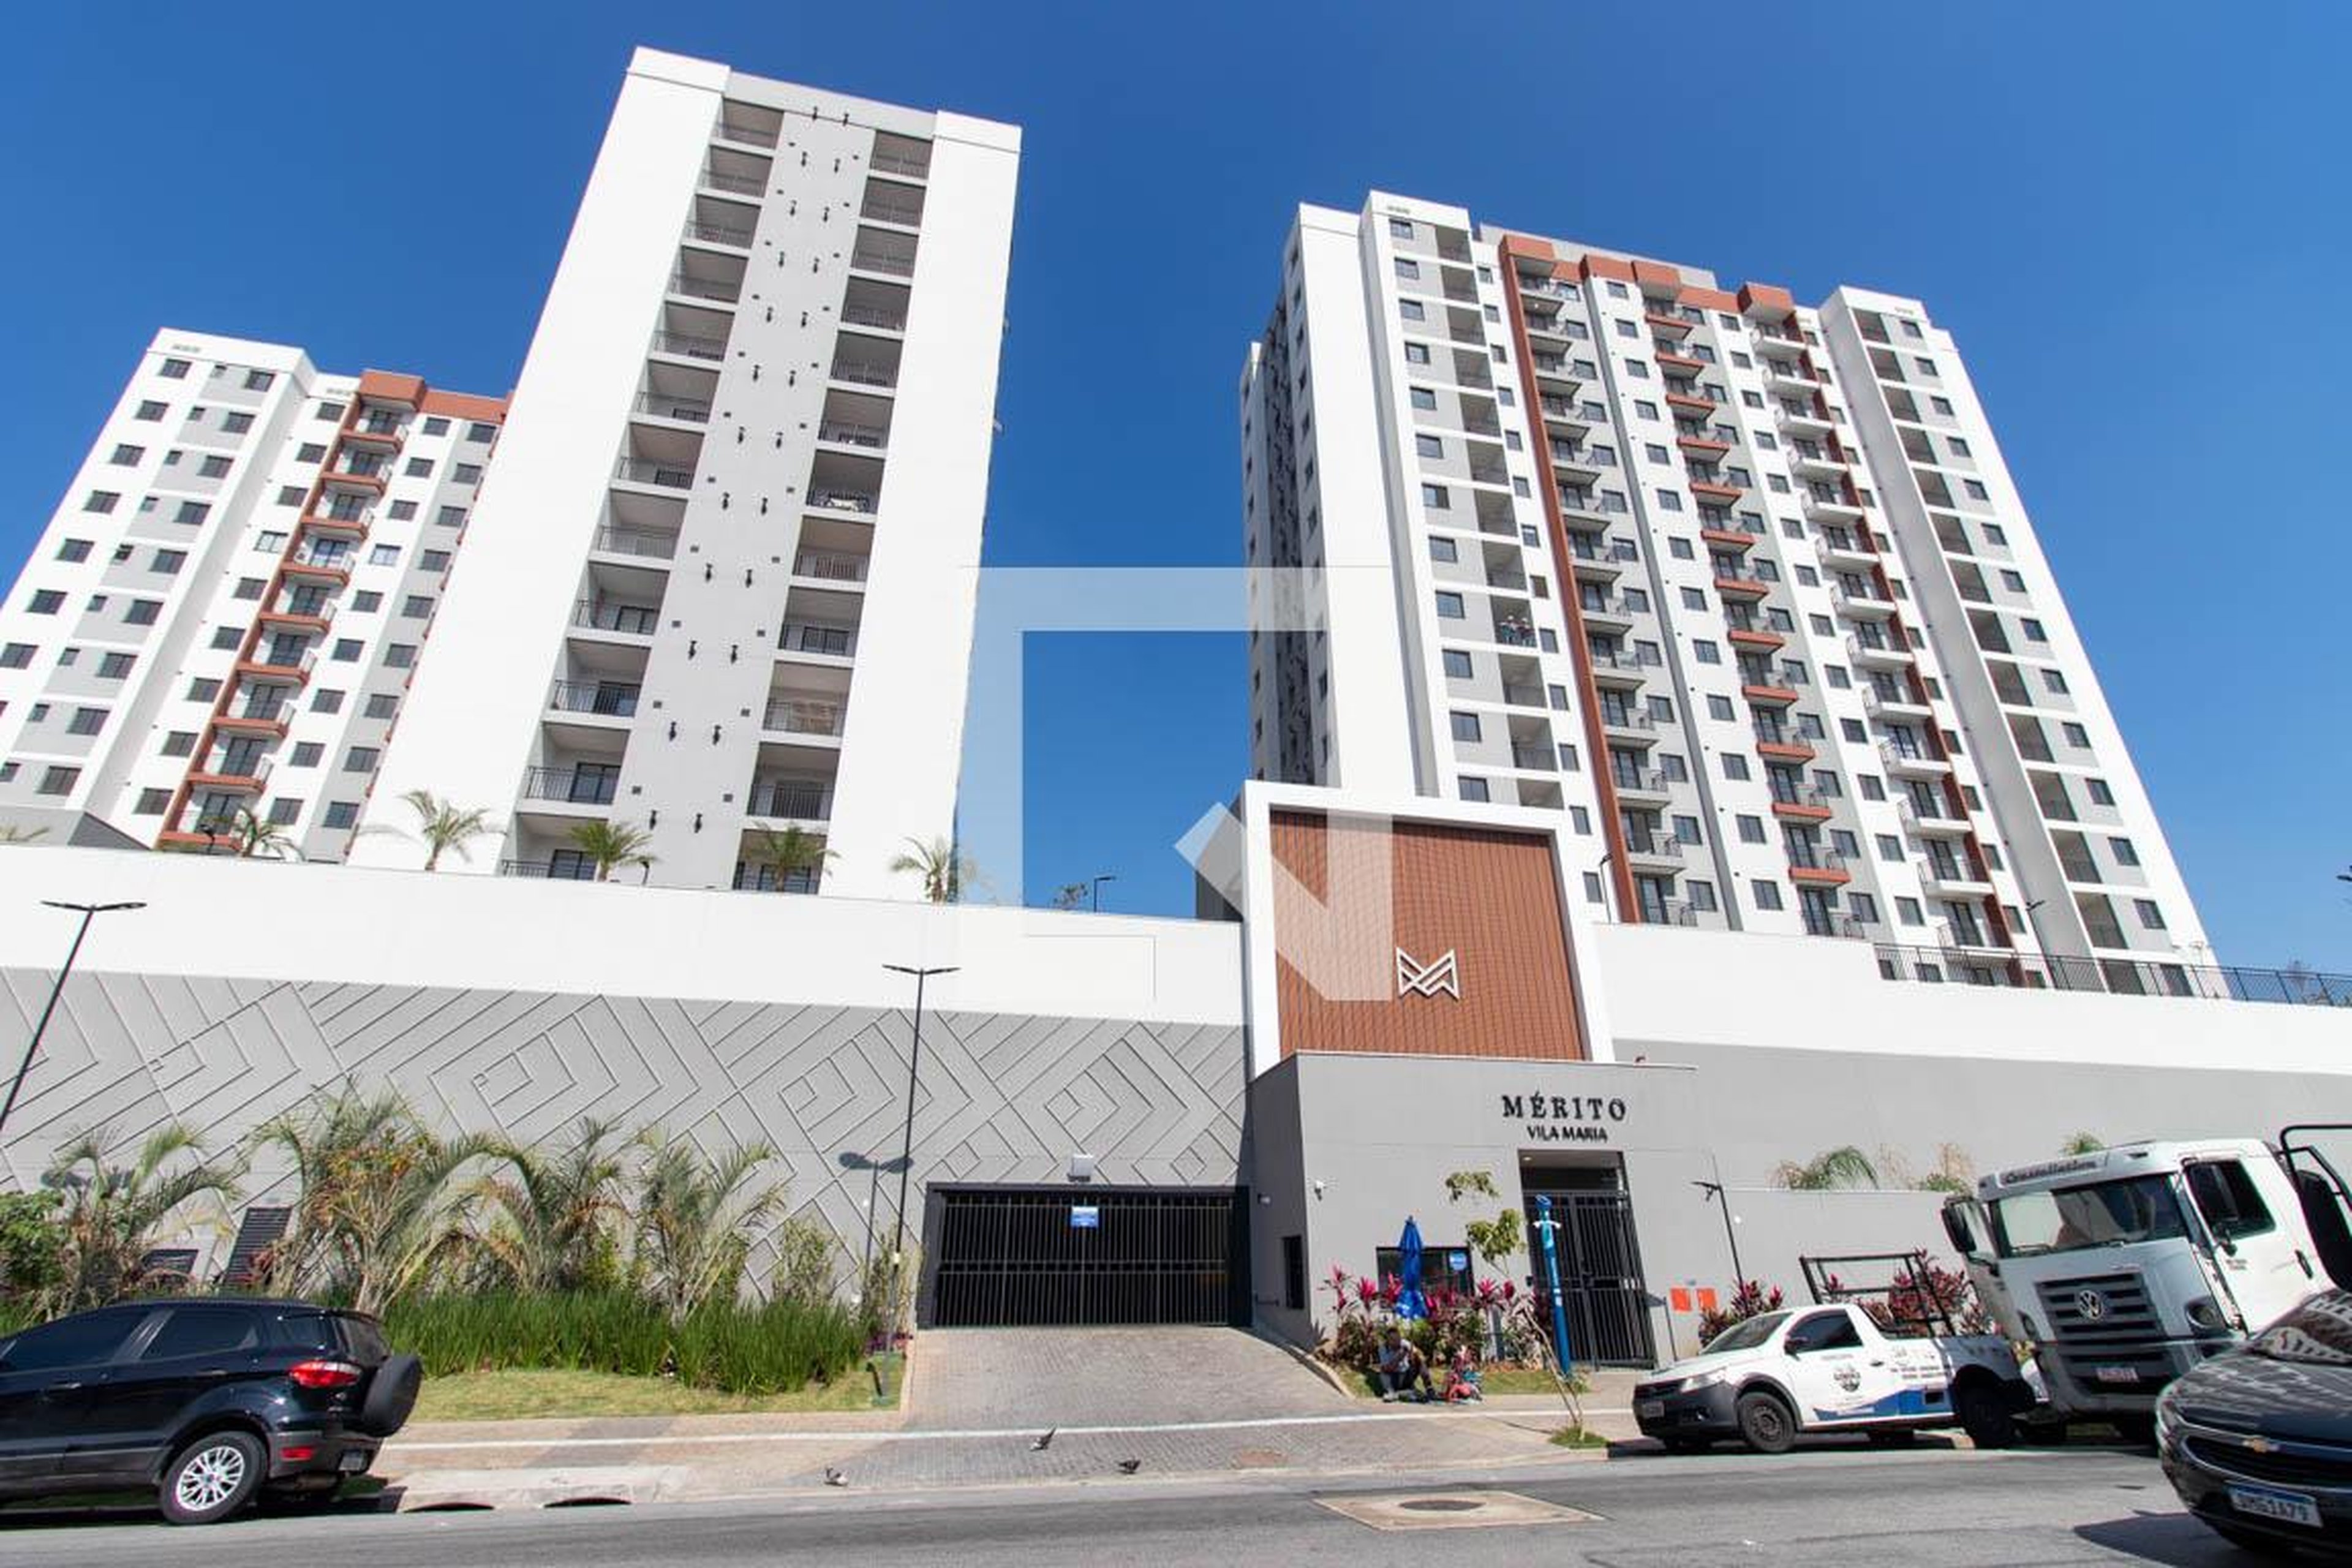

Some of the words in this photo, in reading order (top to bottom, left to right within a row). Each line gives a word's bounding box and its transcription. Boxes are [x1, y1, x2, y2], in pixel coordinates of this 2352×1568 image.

[1502, 1090, 1626, 1121] MÉRITO
[1527, 1125, 1559, 1142] VILA
[1562, 1126, 1608, 1144] MARIA
